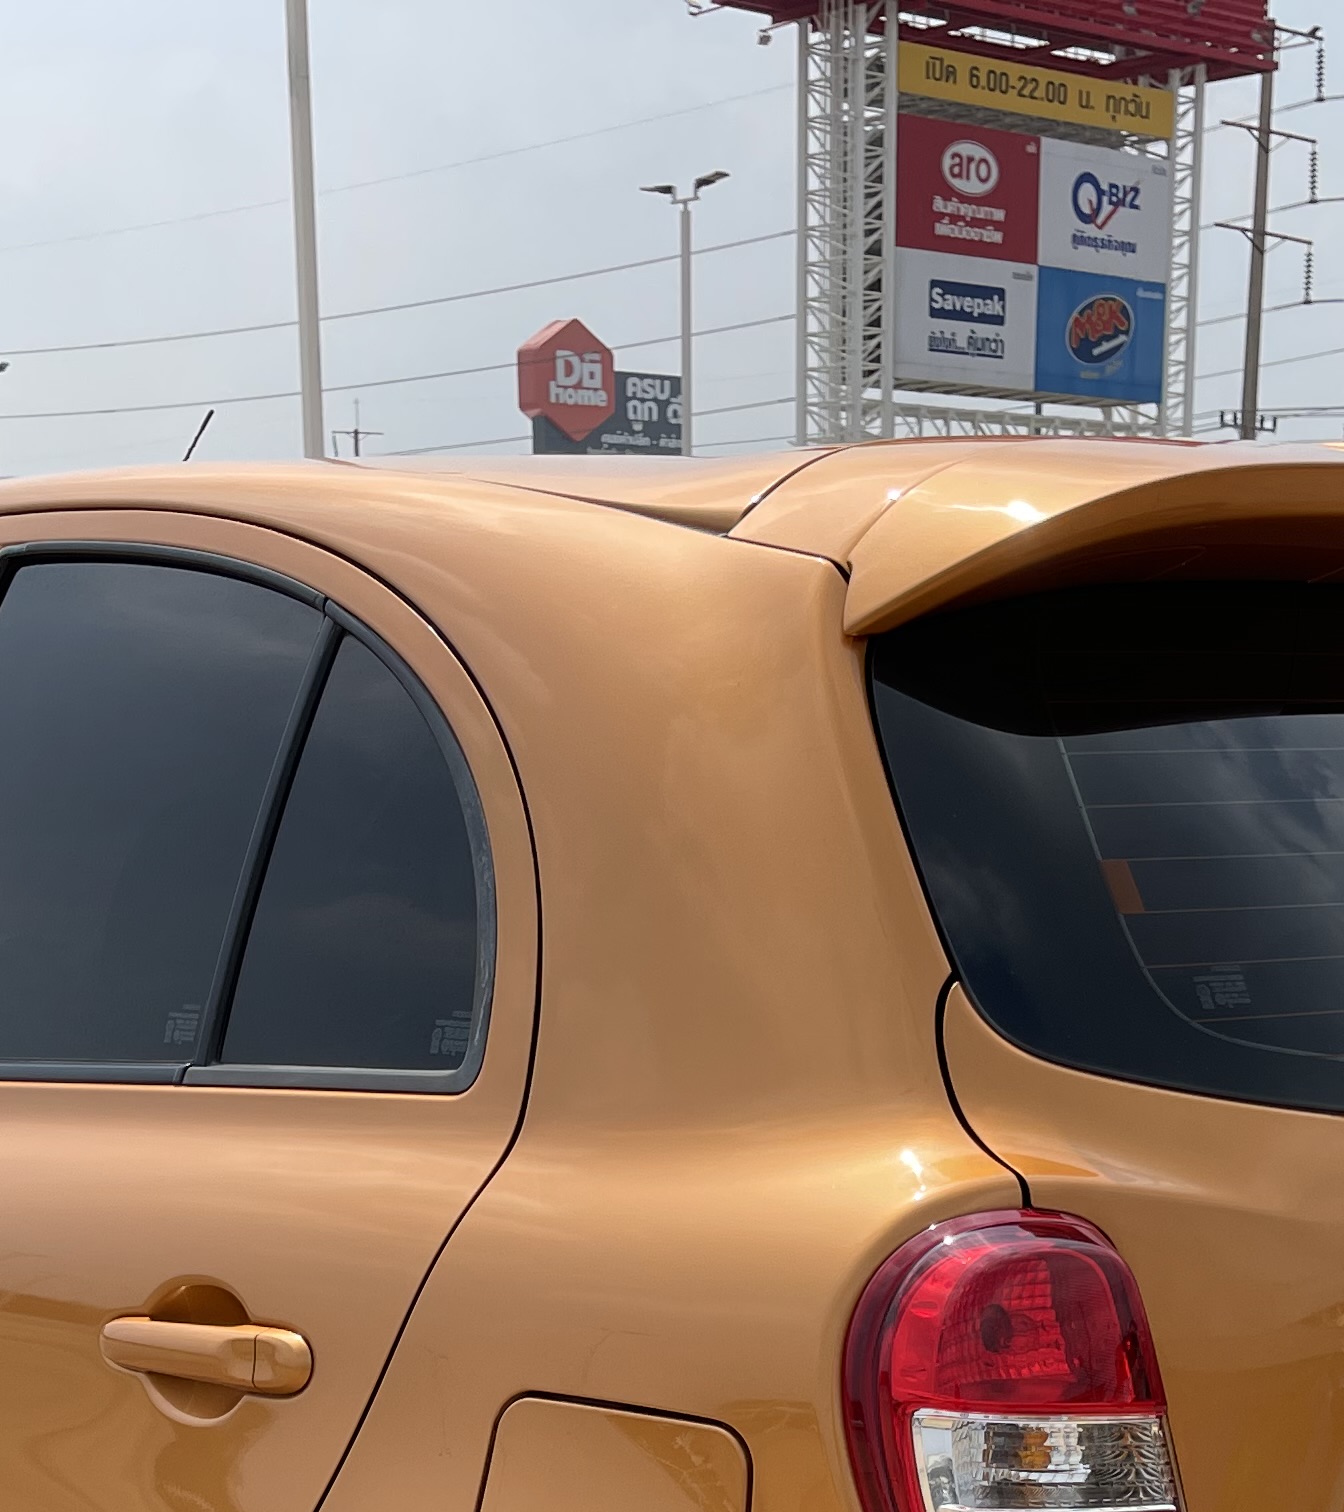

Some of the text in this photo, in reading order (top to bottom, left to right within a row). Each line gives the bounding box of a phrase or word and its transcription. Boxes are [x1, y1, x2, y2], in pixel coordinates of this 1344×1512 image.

[925, 55, 1152, 123] เปิด 6.00-22.00 น. ทุกวัน
[949, 151, 992, 184] aro
[931, 287, 1004, 318] Savepak
[549, 381, 609, 407] home
